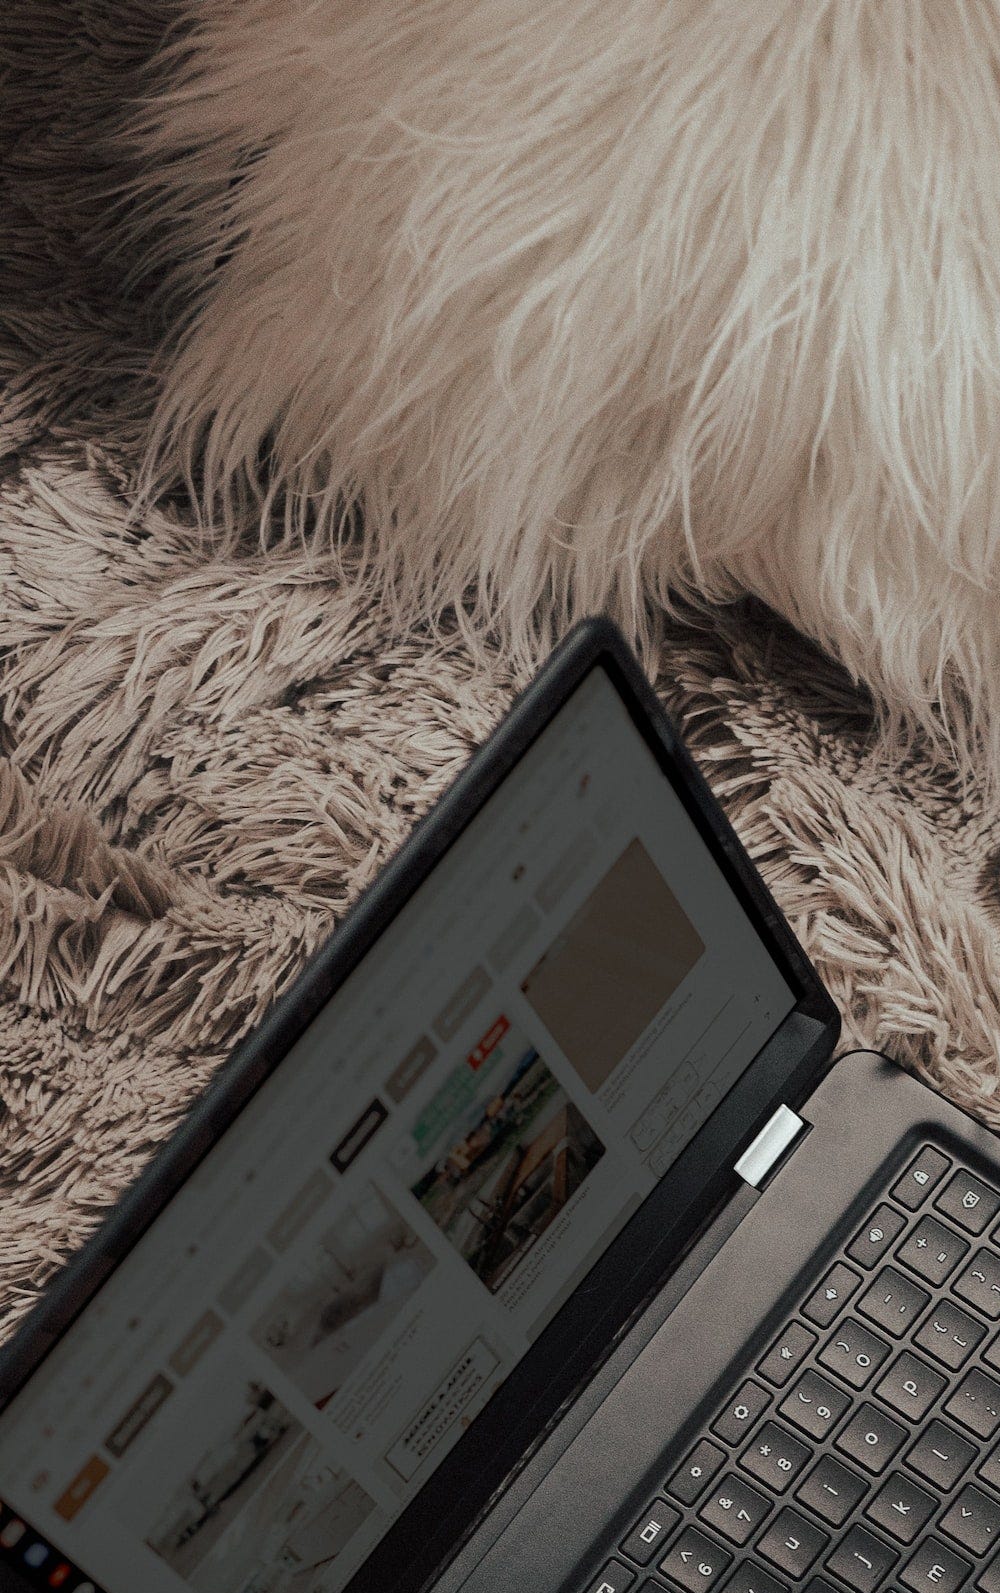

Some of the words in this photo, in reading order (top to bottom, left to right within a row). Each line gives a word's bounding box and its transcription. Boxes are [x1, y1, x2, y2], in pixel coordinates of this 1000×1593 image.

[902, 1380, 919, 1398] p
[815, 1405, 832, 1421] 9
[864, 1432, 879, 1445] o
[777, 1457, 792, 1473] 8
[823, 1484, 839, 1496] i
[716, 1496, 734, 1511] &
[891, 1501, 911, 1515] k
[735, 1509, 751, 1522] 7
[784, 1536, 801, 1550] u
[854, 1552, 873, 1569] j
[698, 1561, 713, 1577] 6
[926, 1563, 946, 1584] m
